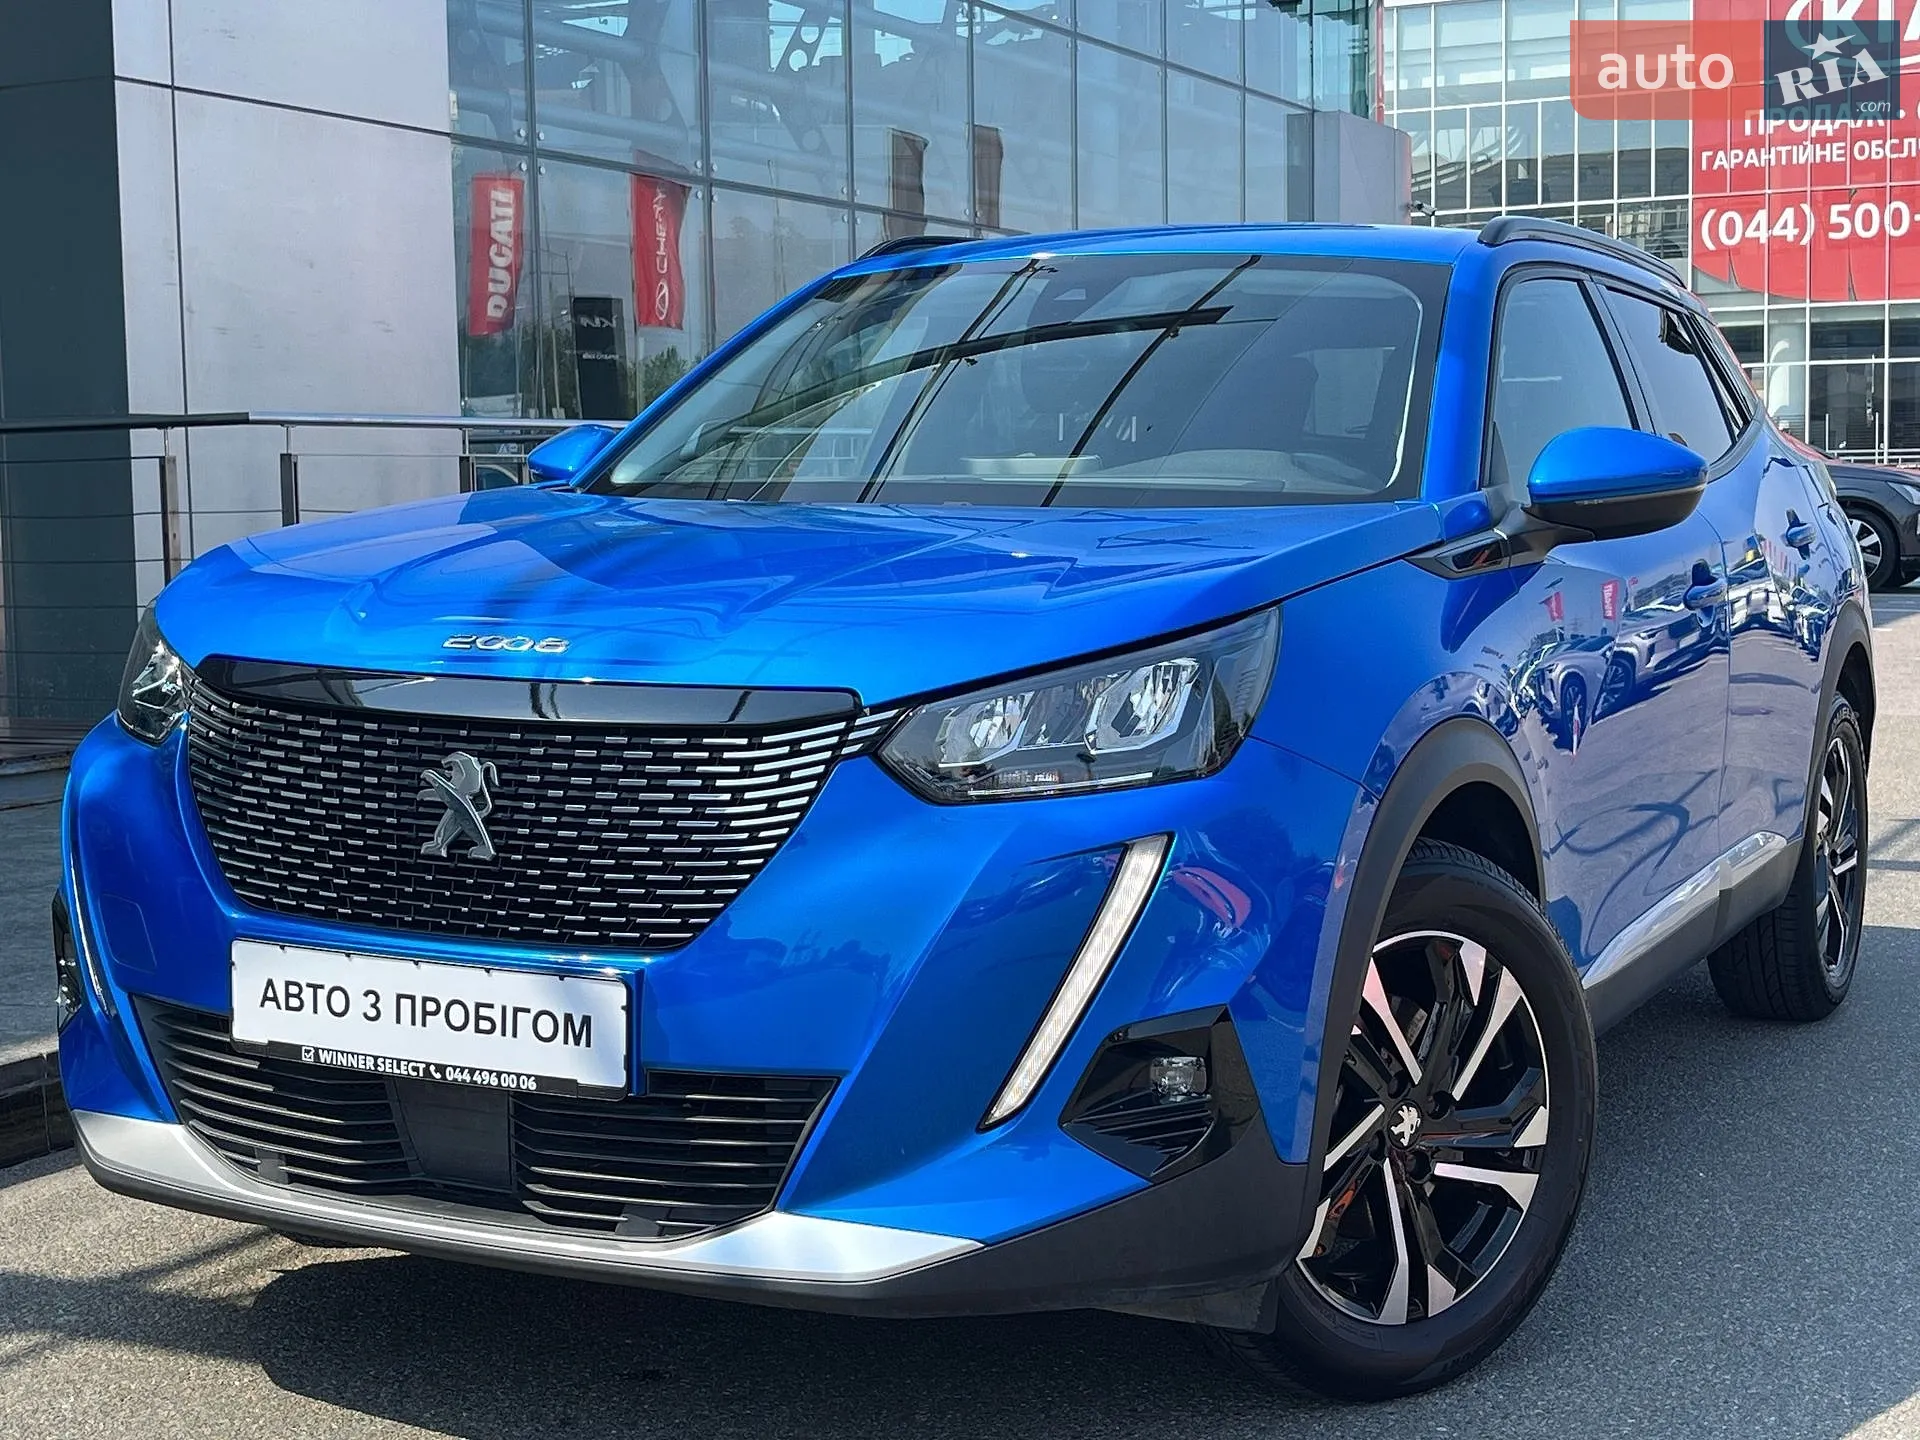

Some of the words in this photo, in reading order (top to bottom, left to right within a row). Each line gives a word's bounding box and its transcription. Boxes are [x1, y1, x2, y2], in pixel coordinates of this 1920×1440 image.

[1701, 140, 1846, 171] ГАРАНТІЙНЕ
[1853, 137, 1920, 161] ОБСЛ
[1701, 203, 1815, 250] (044)
[487, 188, 515, 319] DUCATI
[442, 634, 570, 653] 2008
[260, 977, 351, 1018] АВТО
[395, 993, 592, 1048] ПРОБІГОМ
[318, 1048, 375, 1071] WINNER
[377, 1057, 426, 1077] SELECT
[445, 1066, 471, 1083] 044
[473, 1069, 499, 1086] 496
[500, 1073, 517, 1089] 00
[519, 1075, 537, 1091] 06
